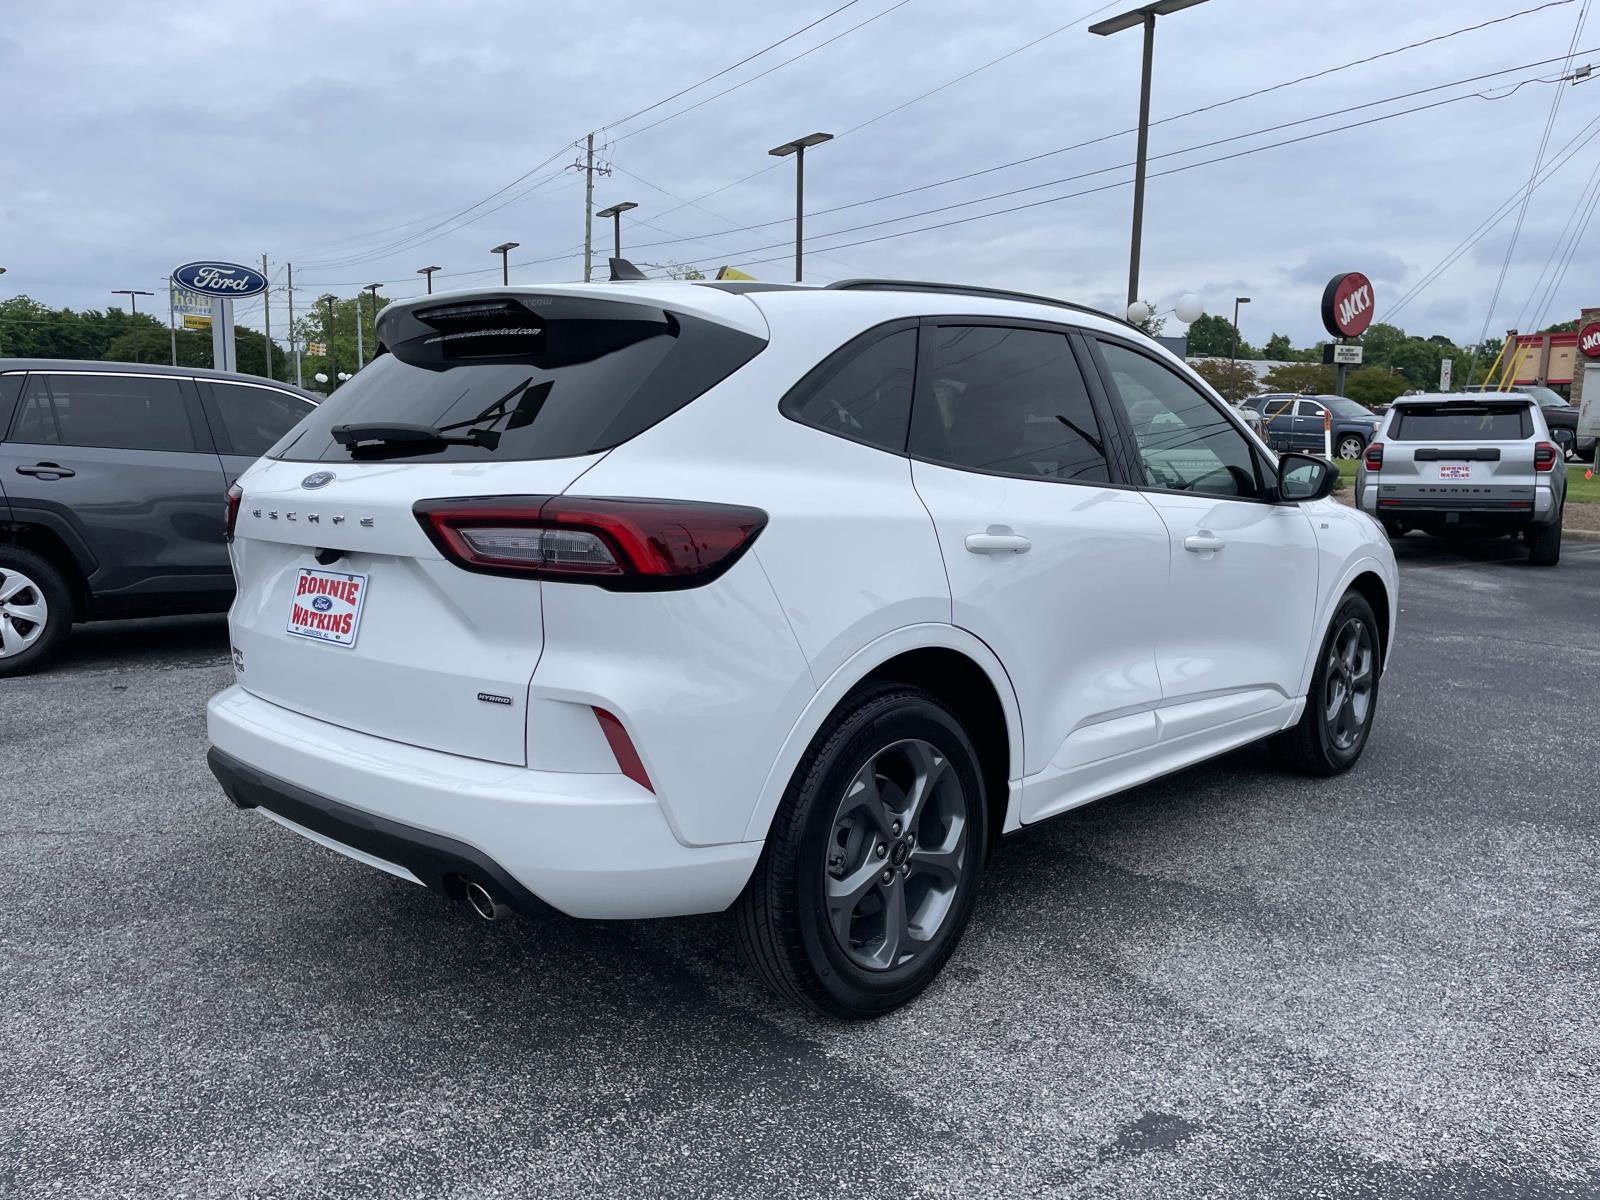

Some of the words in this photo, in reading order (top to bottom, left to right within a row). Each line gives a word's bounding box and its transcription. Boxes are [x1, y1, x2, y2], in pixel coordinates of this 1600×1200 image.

[193, 267, 249, 291] Ford
[1340, 285, 1370, 326] JACK'S
[253, 509, 374, 527] ESCAPE
[297, 575, 359, 606] RONNIE
[292, 603, 353, 635] WATKINS
[479, 694, 510, 703] HYBRID
